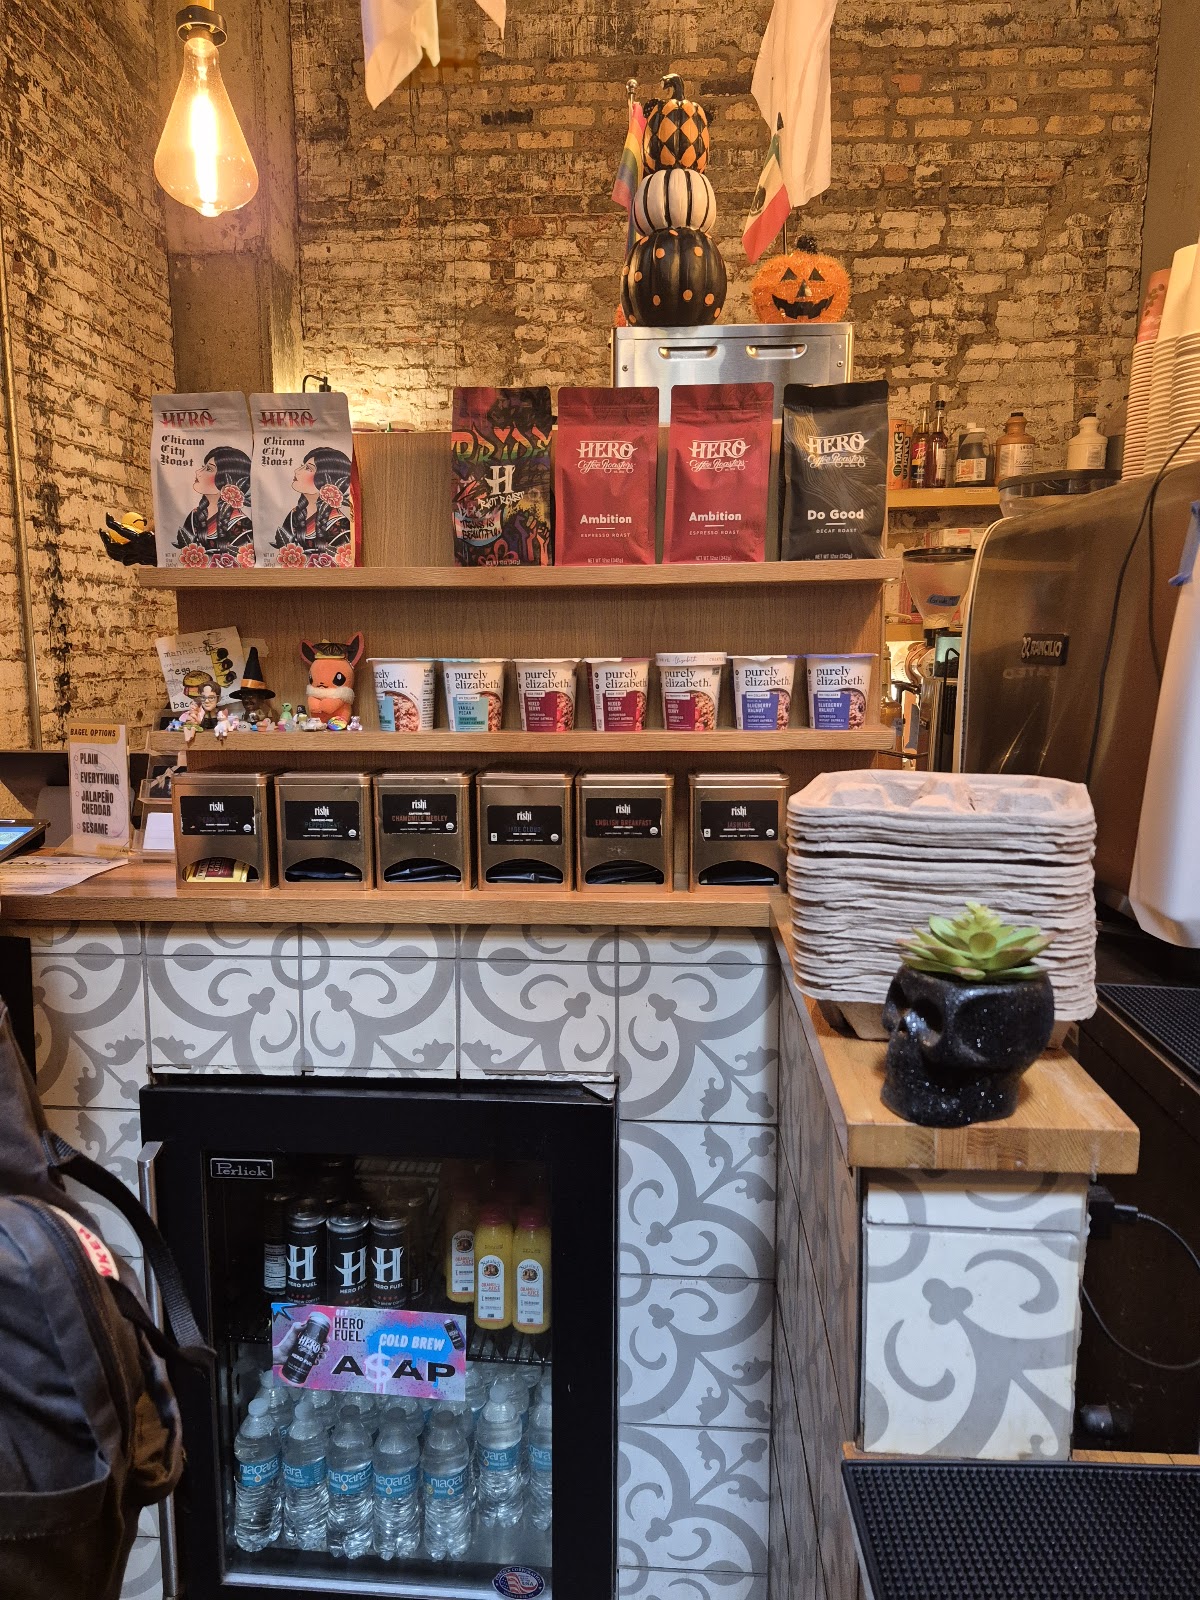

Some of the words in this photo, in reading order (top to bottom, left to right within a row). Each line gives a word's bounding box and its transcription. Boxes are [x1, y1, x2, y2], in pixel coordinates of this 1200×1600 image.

[162, 435, 205, 446] Chicana
[264, 436, 305, 446] Chicana
[805, 432, 869, 454] HERO
[161, 445, 185, 458] City
[262, 448, 285, 458] City
[576, 441, 638, 459] HERO
[688, 438, 751, 458] HERO
[894, 432, 905, 464] TANG
[161, 454, 194, 467] Roast
[262, 456, 293, 467] Roast
[484, 465, 516, 496] H
[580, 514, 632, 524] Ambition
[689, 511, 742, 522] Ambition
[808, 510, 826, 520] Do
[830, 508, 864, 520] Good
[175, 667, 191, 675] egg
[455, 670, 488, 681] purely
[525, 669, 557, 680] purely
[605, 669, 638, 680] purely
[665, 668, 696, 680] purely
[745, 667, 779, 678] purely
[816, 666, 851, 677] purely
[665, 678, 711, 687] elizabeth.
[816, 676, 865, 685] elizabeth.
[173, 701, 192, 709] bac
[70, 728, 88, 736] BAGEL
[90, 729, 116, 737] OPTIONS
[80, 753, 98, 764] PLAIN
[80, 772, 119, 785] EVERYTHING
[81, 789, 114, 804] JALAPEÑO
[82, 803, 111, 816] CHEDDAR
[209, 801, 224, 812] rishi
[314, 805, 329, 816] rishi
[411, 799, 427, 810] rishi
[615, 803, 631, 815] rishi
[516, 811, 532, 821] rishi
[731, 805, 747, 817] rishi
[82, 821, 108, 835] SESAME
[216, 1162, 269, 1176] Perlick
[286, 1243, 318, 1281] H
[334, 1245, 368, 1287] H
[371, 1246, 405, 1282] H
[390, 1282, 403, 1290] FUEL
[334, 1317, 363, 1329] HERO
[334, 1330, 365, 1342] FUEL.
[379, 1333, 408, 1348] COLD
[411, 1336, 446, 1352] BREW
[331, 1347, 456, 1389] A$AP
